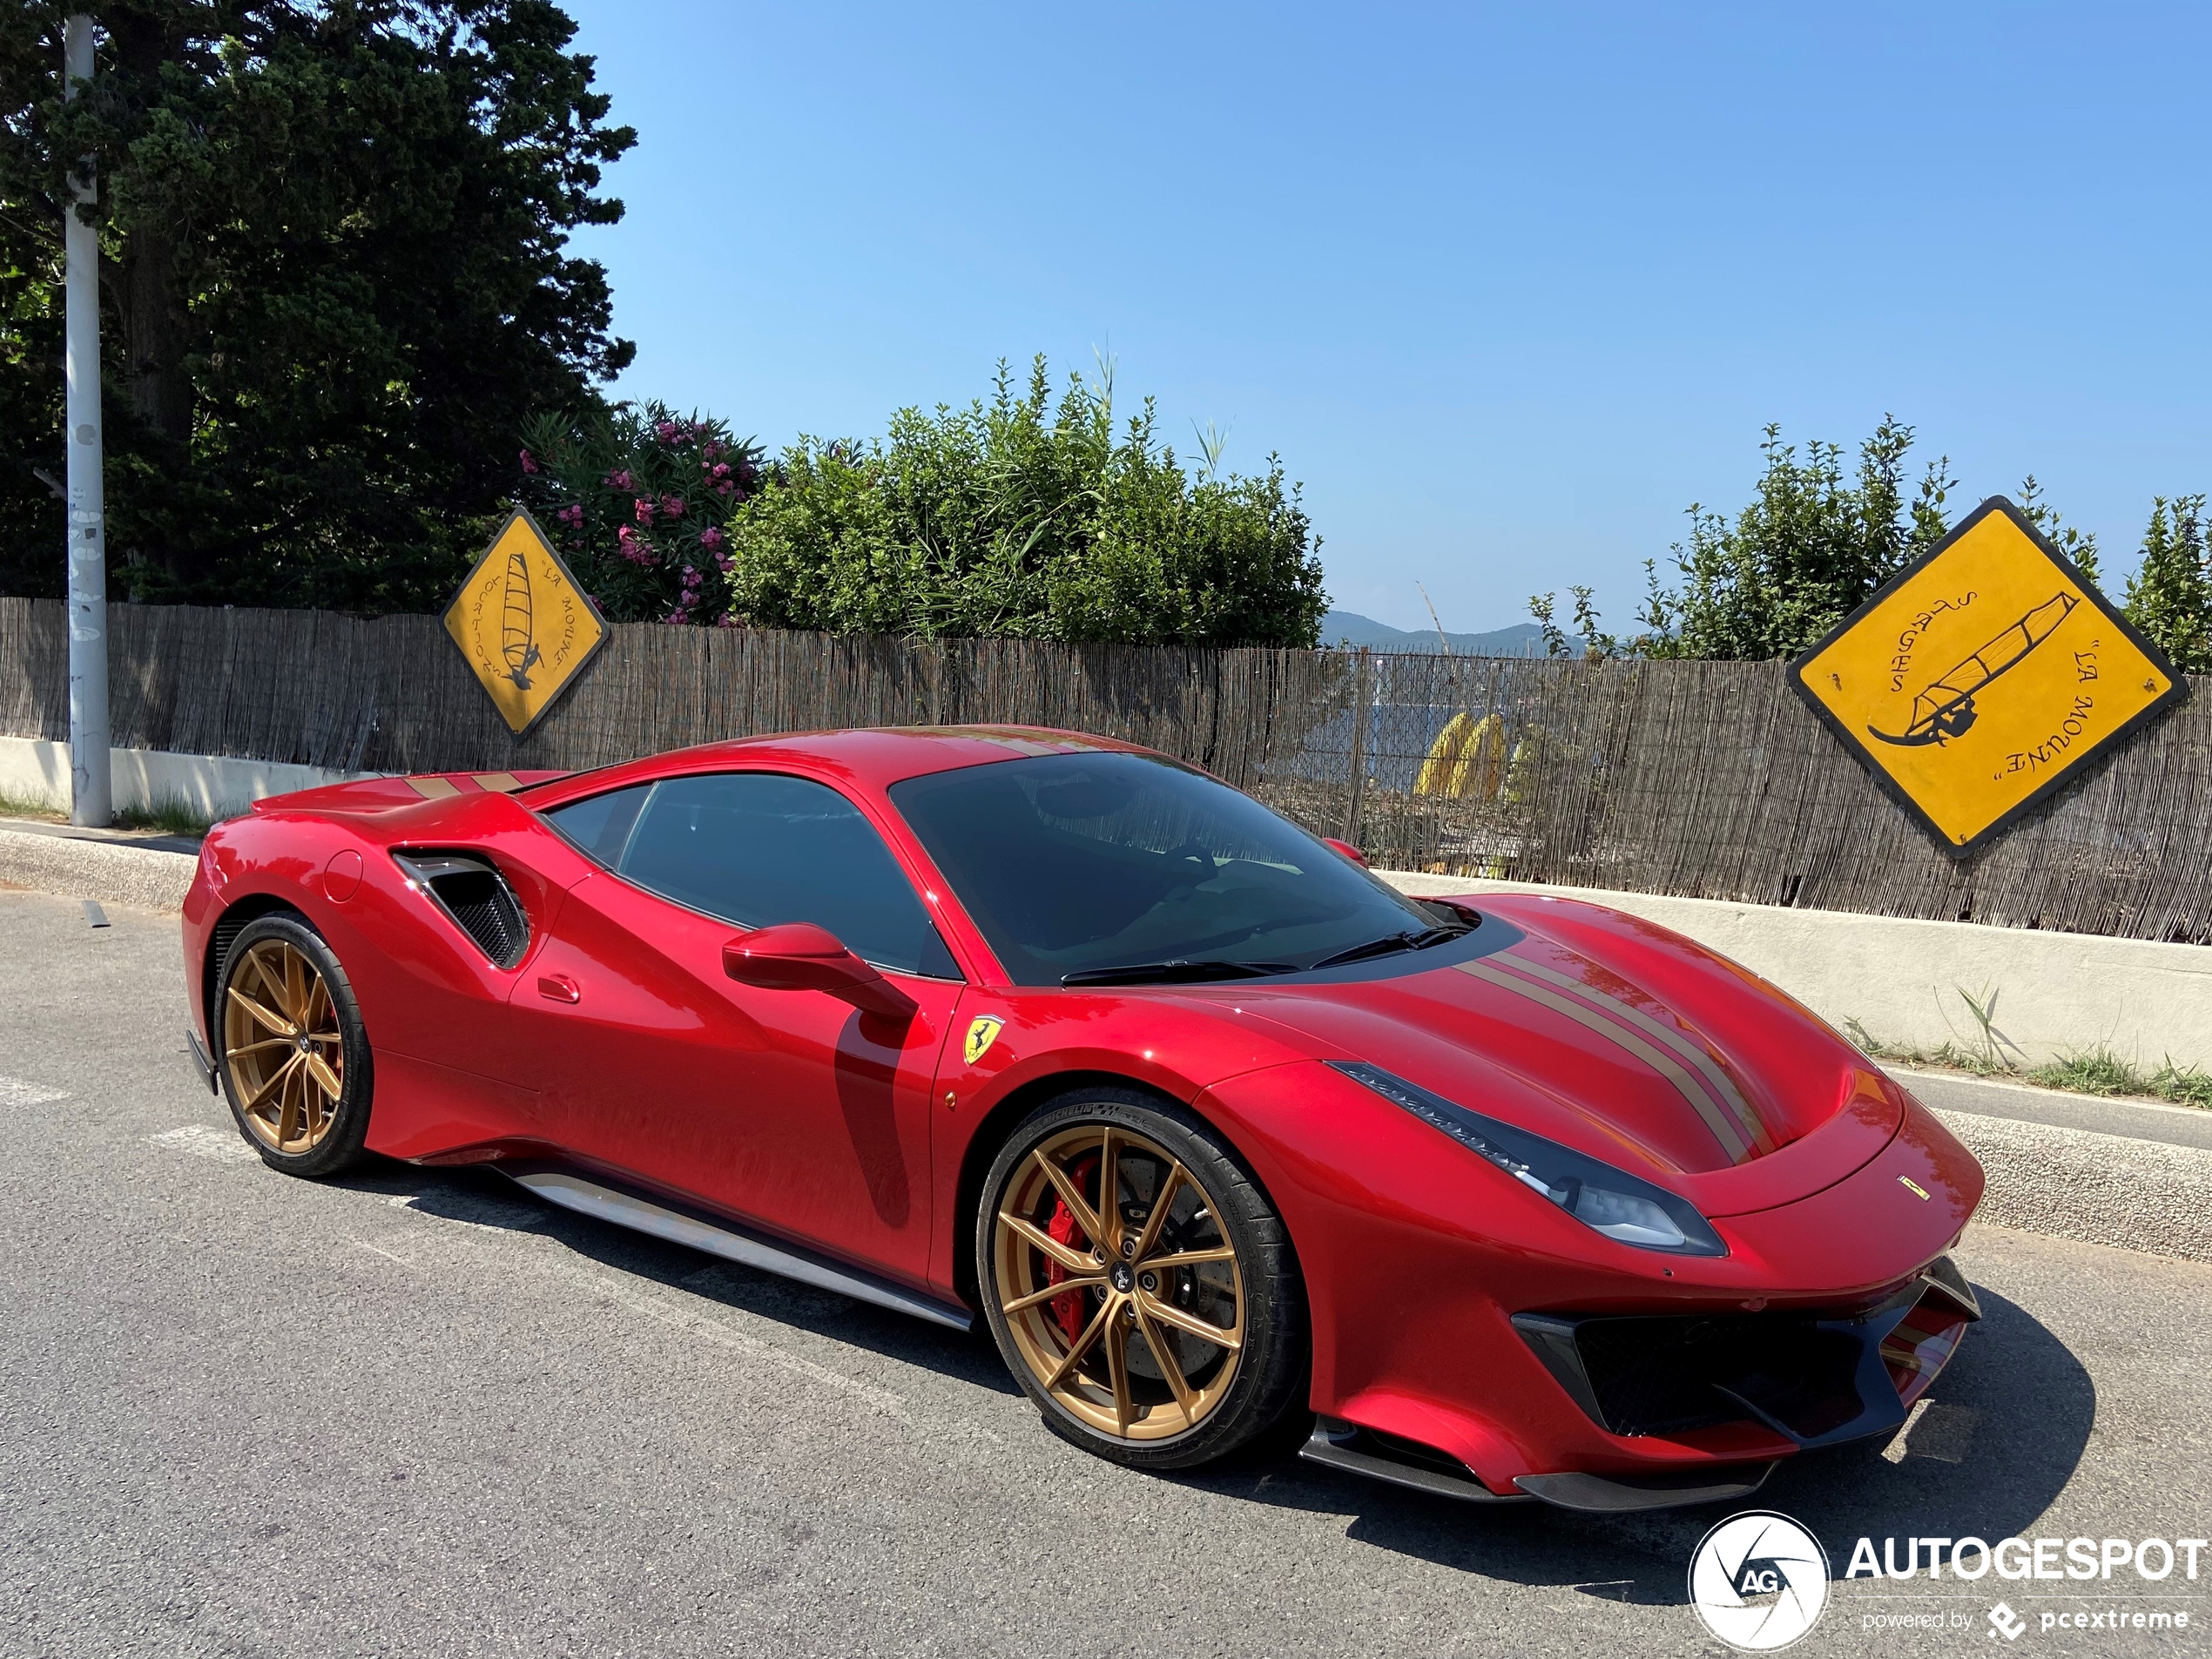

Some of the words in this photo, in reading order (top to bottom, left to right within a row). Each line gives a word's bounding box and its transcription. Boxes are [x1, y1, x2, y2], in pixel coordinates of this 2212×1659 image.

[471, 575, 502, 677] LOCATIONS
[1890, 590, 1979, 693] STAGES
[1042, 1103, 1092, 1124] MICHELIN
